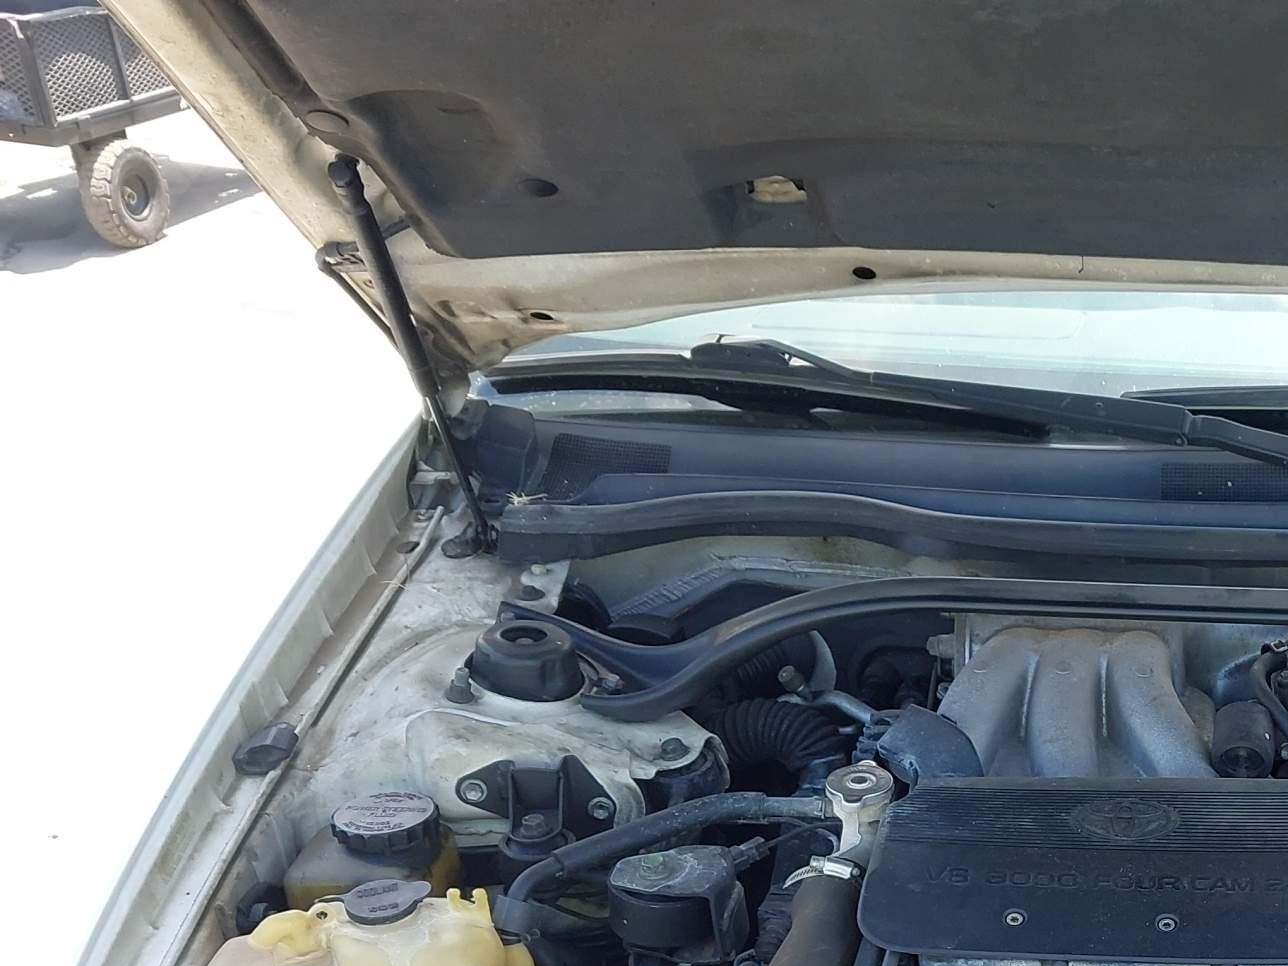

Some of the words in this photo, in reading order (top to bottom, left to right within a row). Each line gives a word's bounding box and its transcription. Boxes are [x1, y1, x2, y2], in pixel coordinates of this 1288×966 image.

[926, 864, 969, 886] V6
[1095, 873, 1182, 892] FOUR
[1194, 875, 1255, 894] CAM
